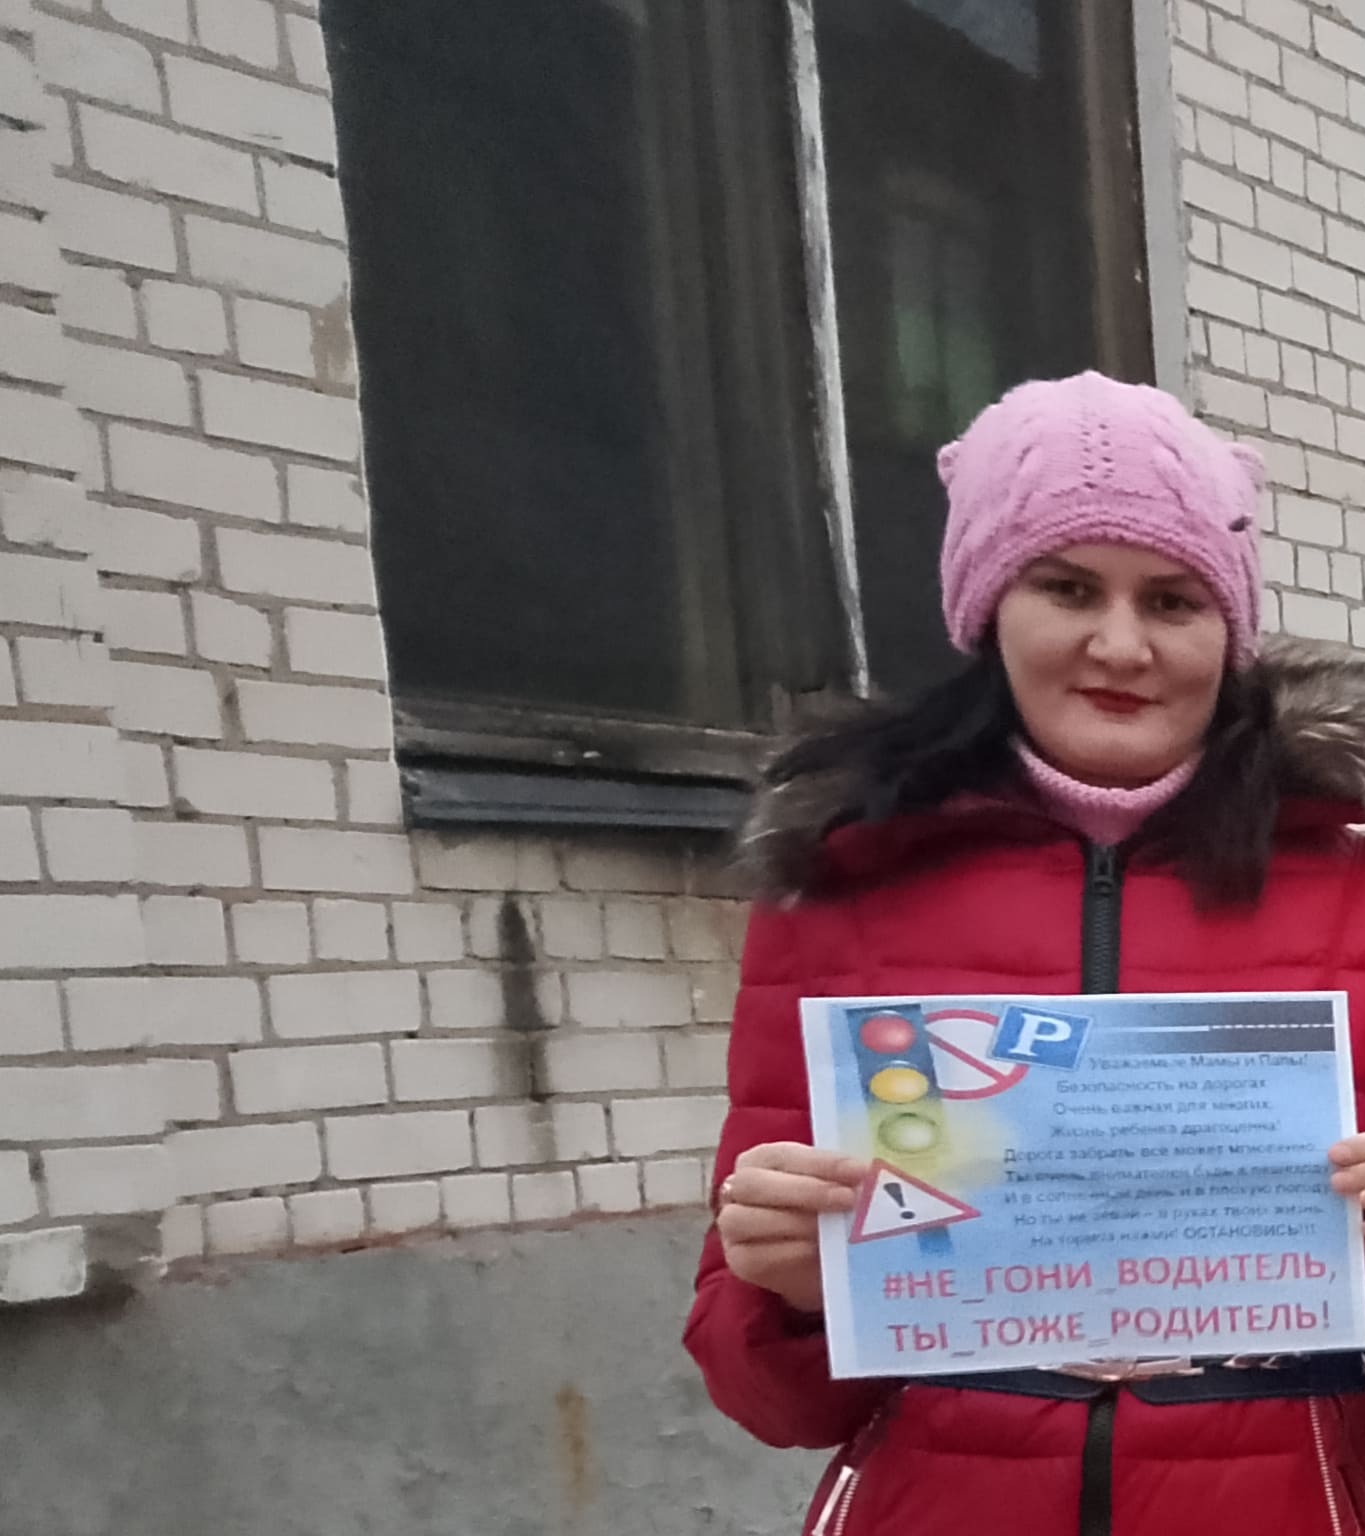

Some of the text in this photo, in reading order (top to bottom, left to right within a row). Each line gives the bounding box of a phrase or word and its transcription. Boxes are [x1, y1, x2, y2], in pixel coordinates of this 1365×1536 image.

[1008, 1012, 1072, 1057] P
[1179, 1080, 1199, 1091] на
[1004, 1148, 1064, 1163] Дорога
